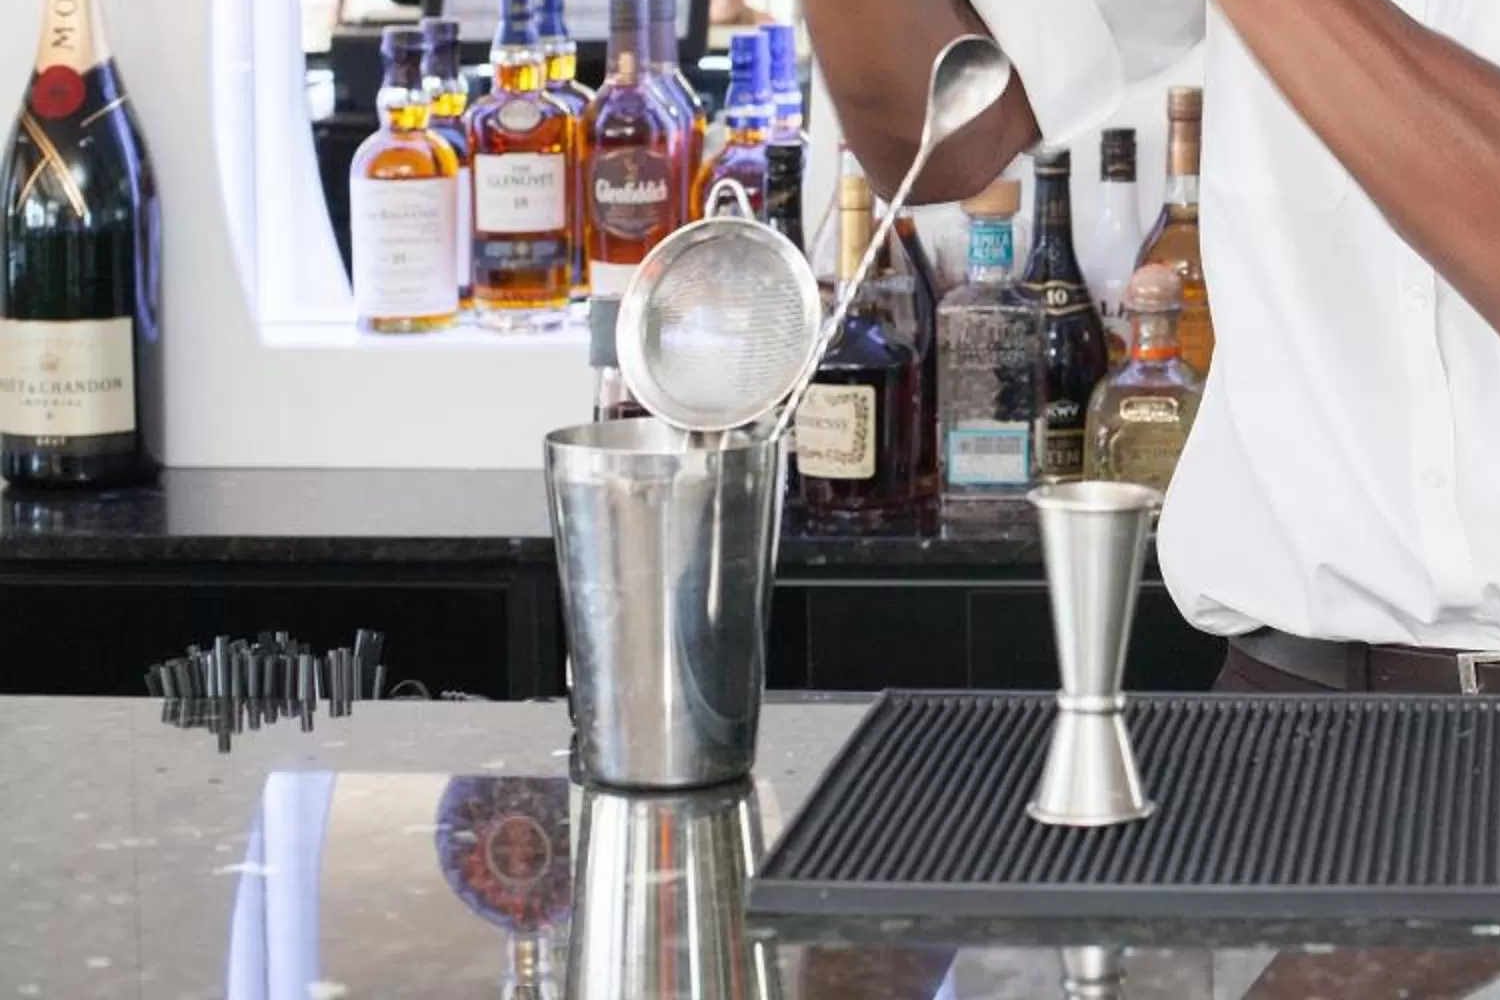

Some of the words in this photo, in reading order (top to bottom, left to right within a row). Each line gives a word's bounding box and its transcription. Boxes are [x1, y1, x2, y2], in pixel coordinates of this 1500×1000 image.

[485, 173, 554, 187] GLENLIVET
[1046, 289, 1068, 304] 10
[39, 378, 122, 394] CHANDON
